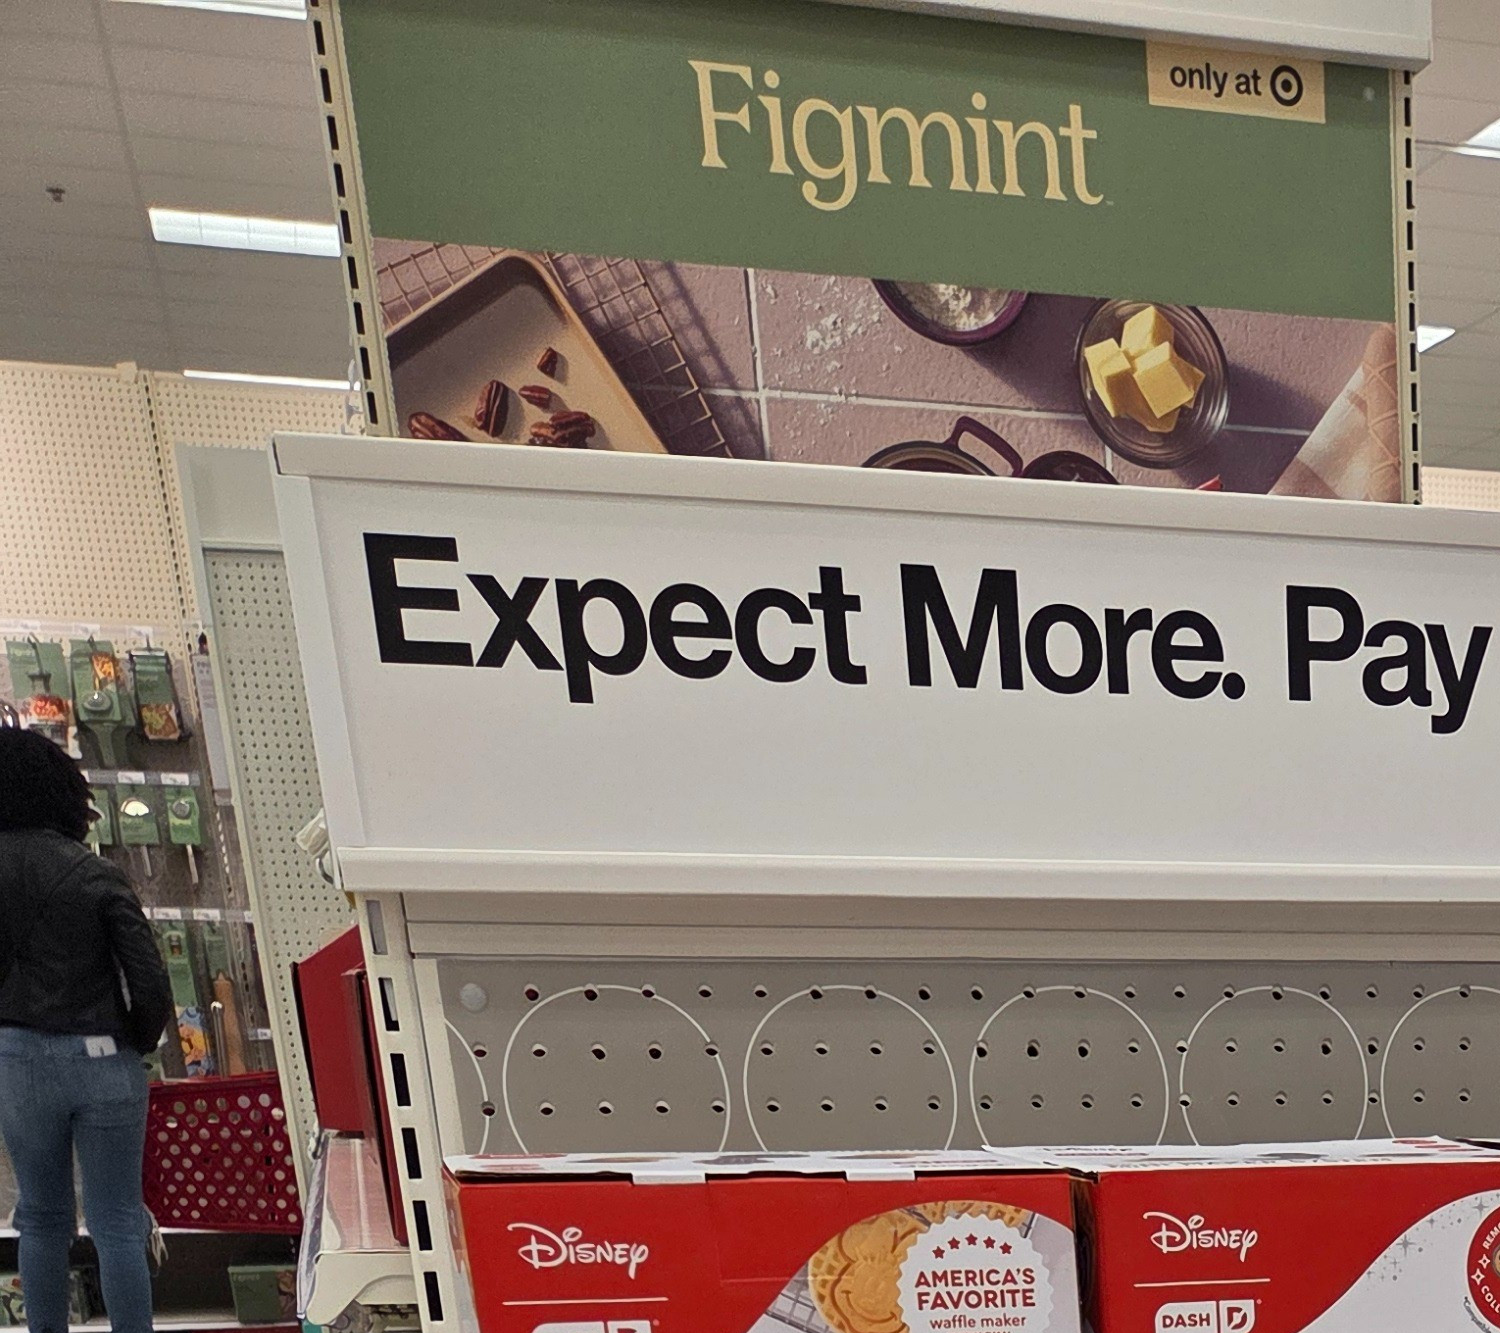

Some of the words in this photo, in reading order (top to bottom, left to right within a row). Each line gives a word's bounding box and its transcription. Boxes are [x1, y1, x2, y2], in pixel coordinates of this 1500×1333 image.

[1169, 62, 1228, 97] only
[1233, 69, 1262, 97] at
[688, 60, 1104, 210] Figmint
[363, 532, 867, 703] Expect
[900, 564, 1245, 700] More.
[1286, 585, 1492, 734] Pay
[507, 1223, 649, 1279] Disney
[1143, 1212, 1258, 1262] Disney
[915, 1268, 1035, 1288] AMERICA'S
[918, 1289, 1035, 1311] FAVORITE
[930, 1314, 969, 1329] waffle
[973, 1314, 1026, 1329] maker
[1162, 1311, 1210, 1327] DASH
